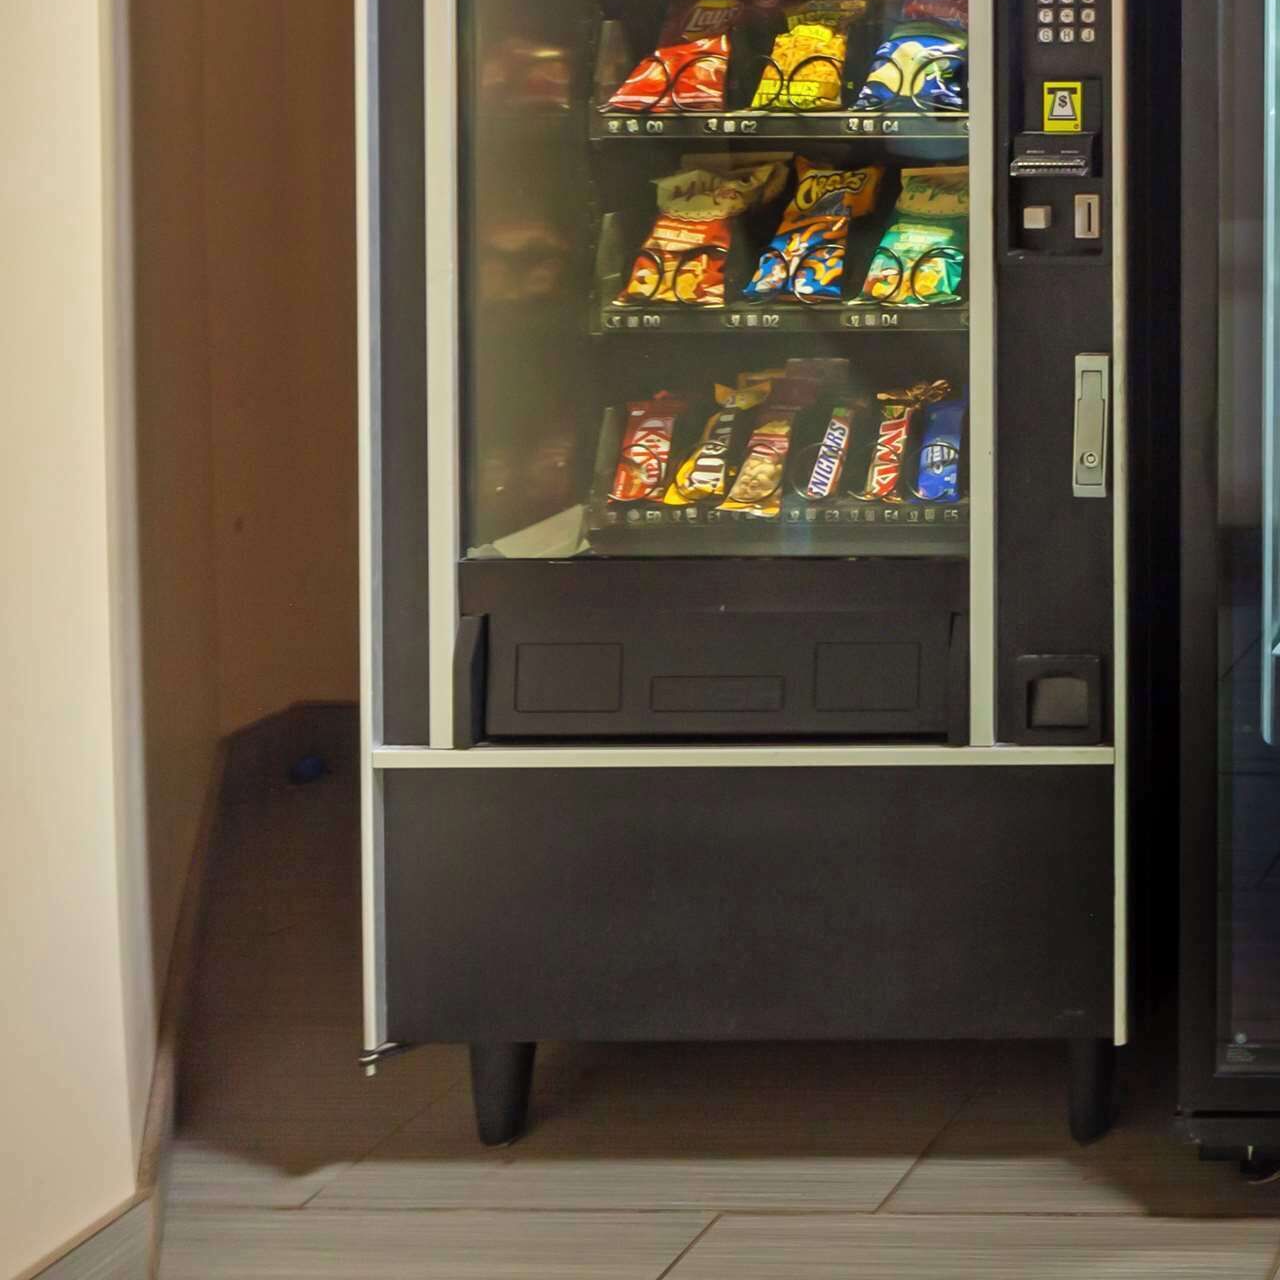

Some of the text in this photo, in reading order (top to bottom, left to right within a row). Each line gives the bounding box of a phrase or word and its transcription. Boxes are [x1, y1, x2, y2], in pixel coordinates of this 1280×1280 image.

[882, 120, 899, 133] C4
[763, 315, 780, 328] D2
[882, 314, 898, 327] D4
